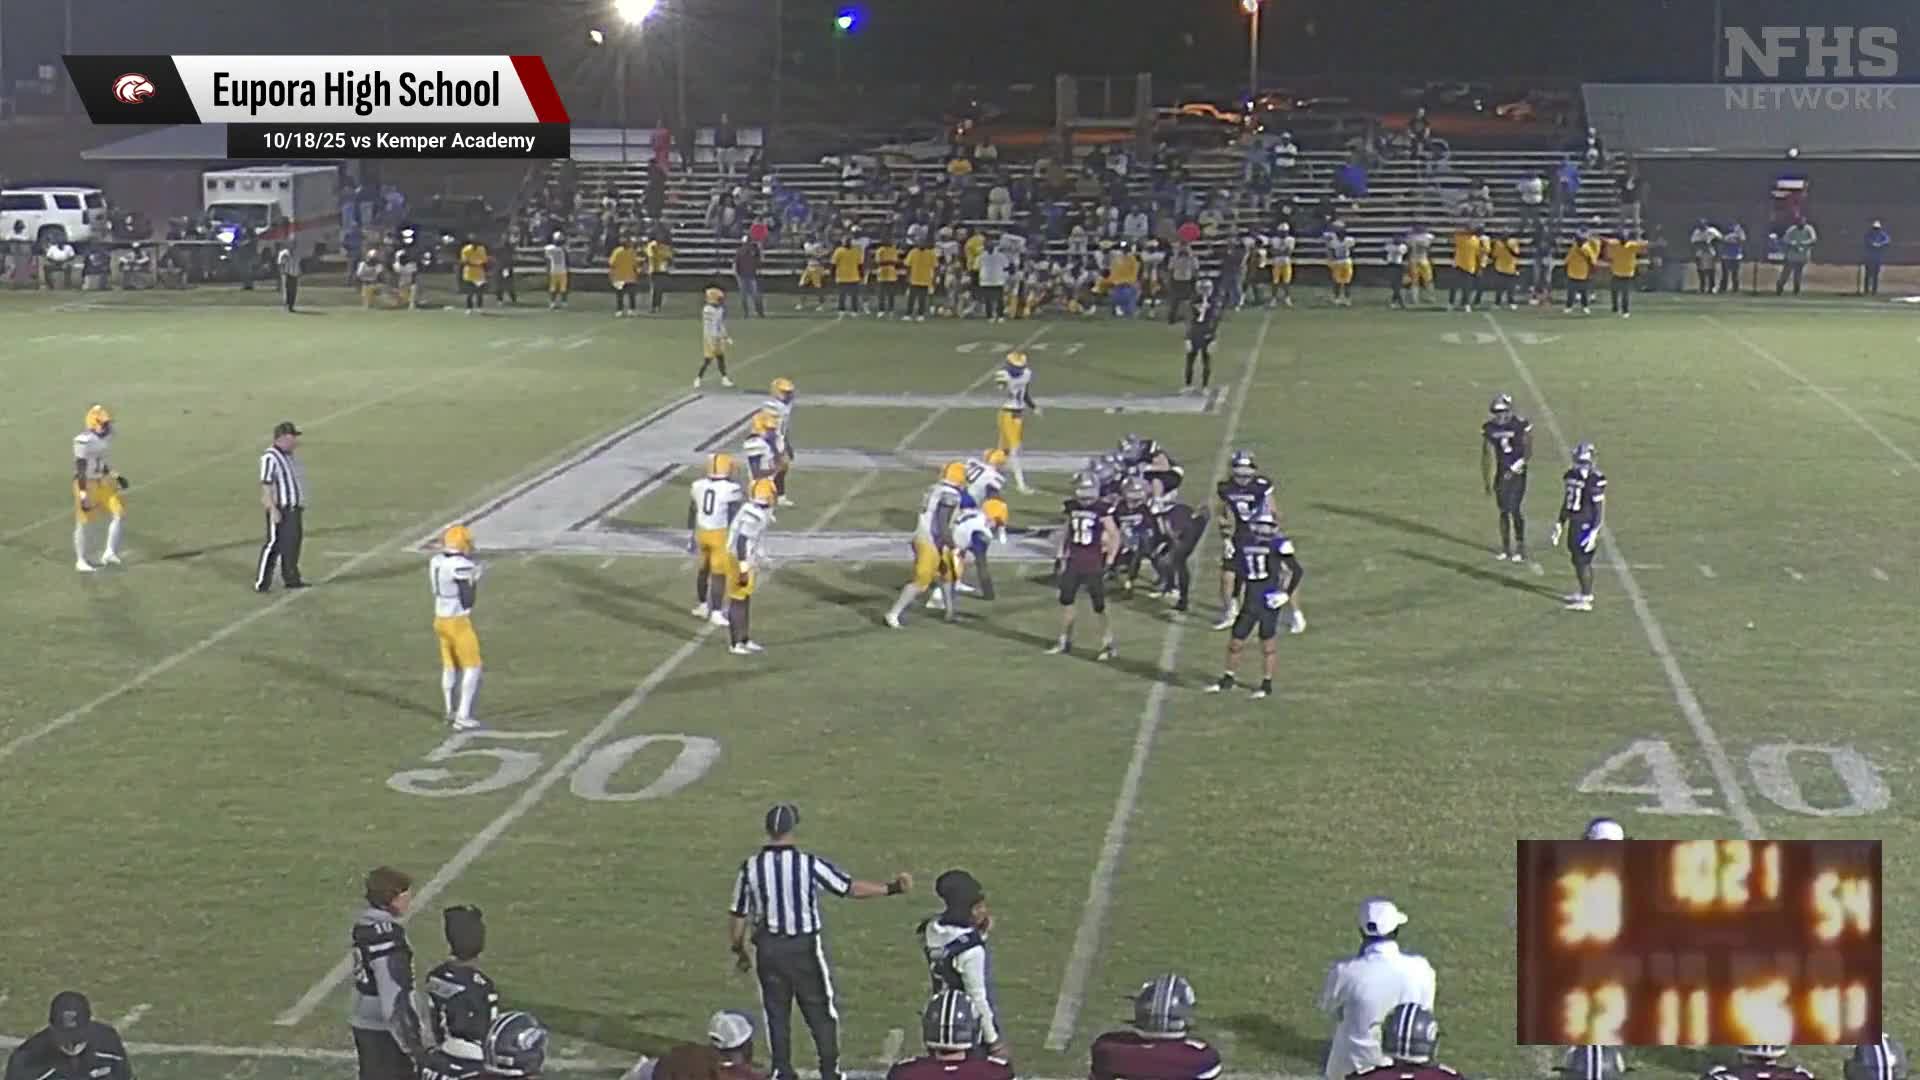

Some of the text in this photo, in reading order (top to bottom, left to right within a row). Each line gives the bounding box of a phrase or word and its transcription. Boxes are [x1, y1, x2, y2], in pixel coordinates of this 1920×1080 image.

[703, 488, 715, 515] 0
[1245, 554, 1269, 580] 11
[386, 729, 721, 801] 50
[1576, 739, 1890, 816] 40
